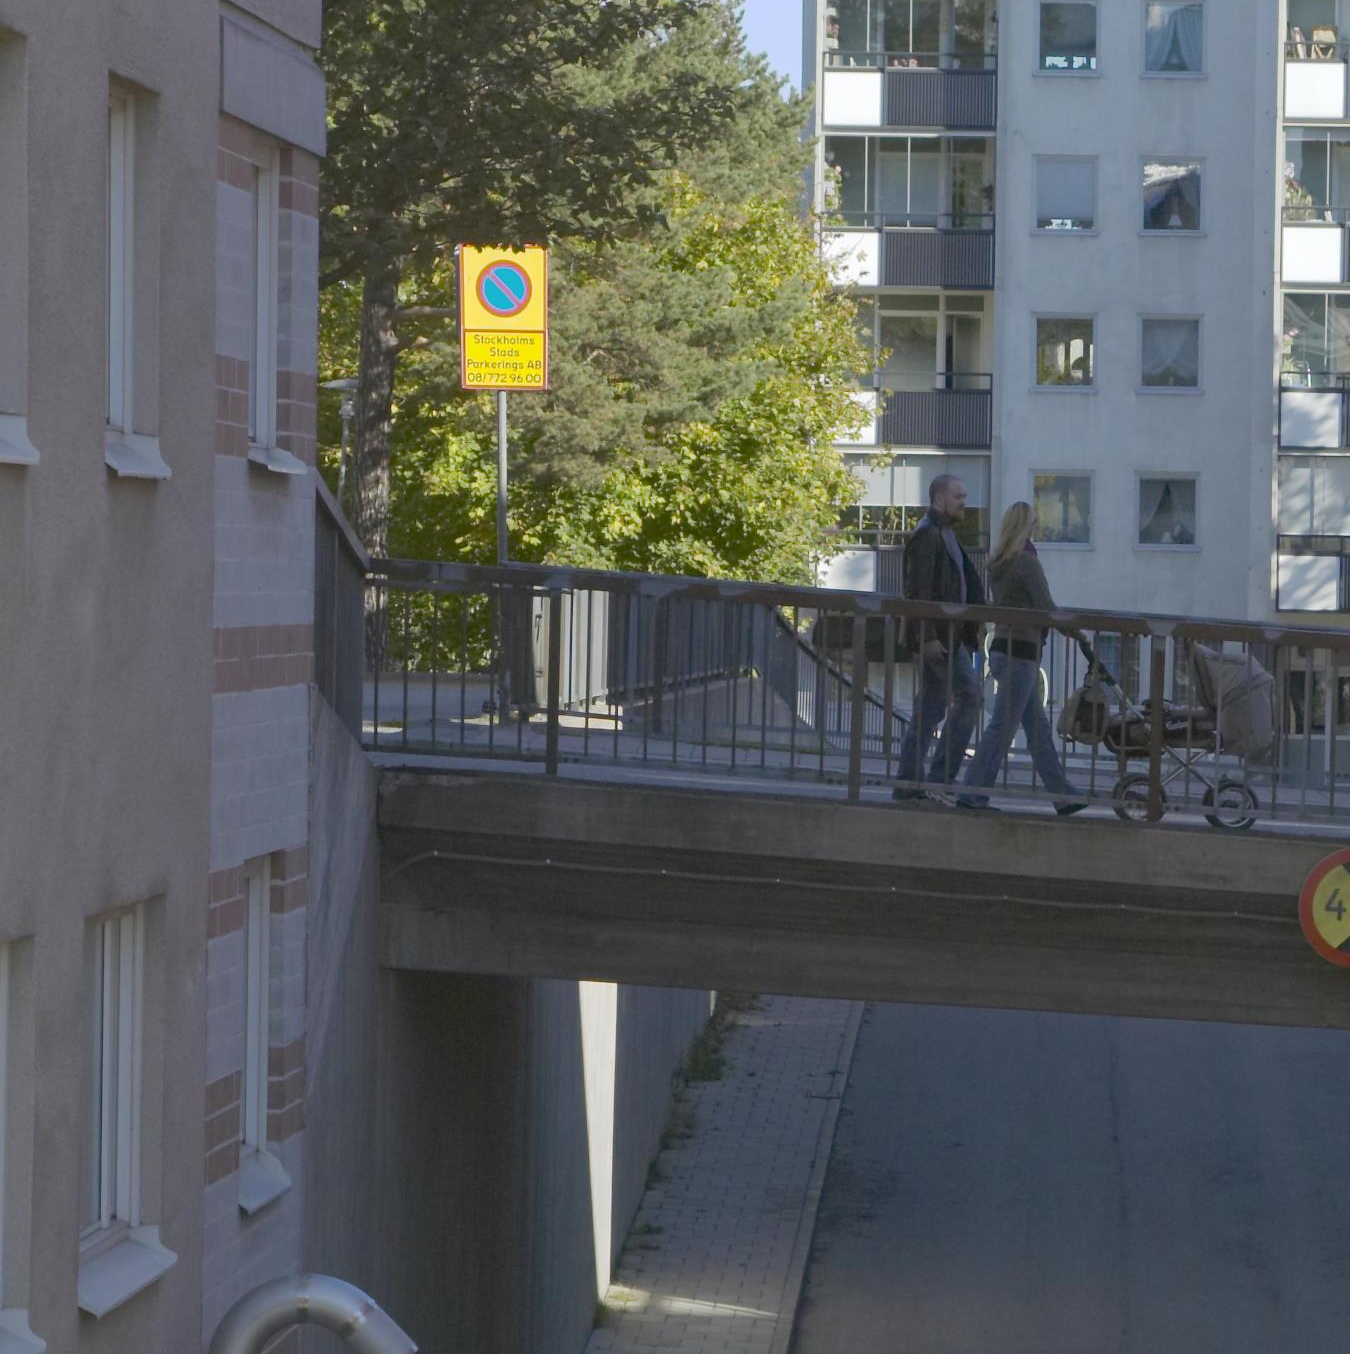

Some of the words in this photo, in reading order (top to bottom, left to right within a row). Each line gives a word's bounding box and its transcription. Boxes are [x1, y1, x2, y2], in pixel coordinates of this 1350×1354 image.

[473, 334, 535, 345] Stockholms
[490, 347, 520, 357] Stads
[467, 358, 524, 371] Parkerings
[527, 360, 542, 370] AB
[526, 373, 542, 383] 00
